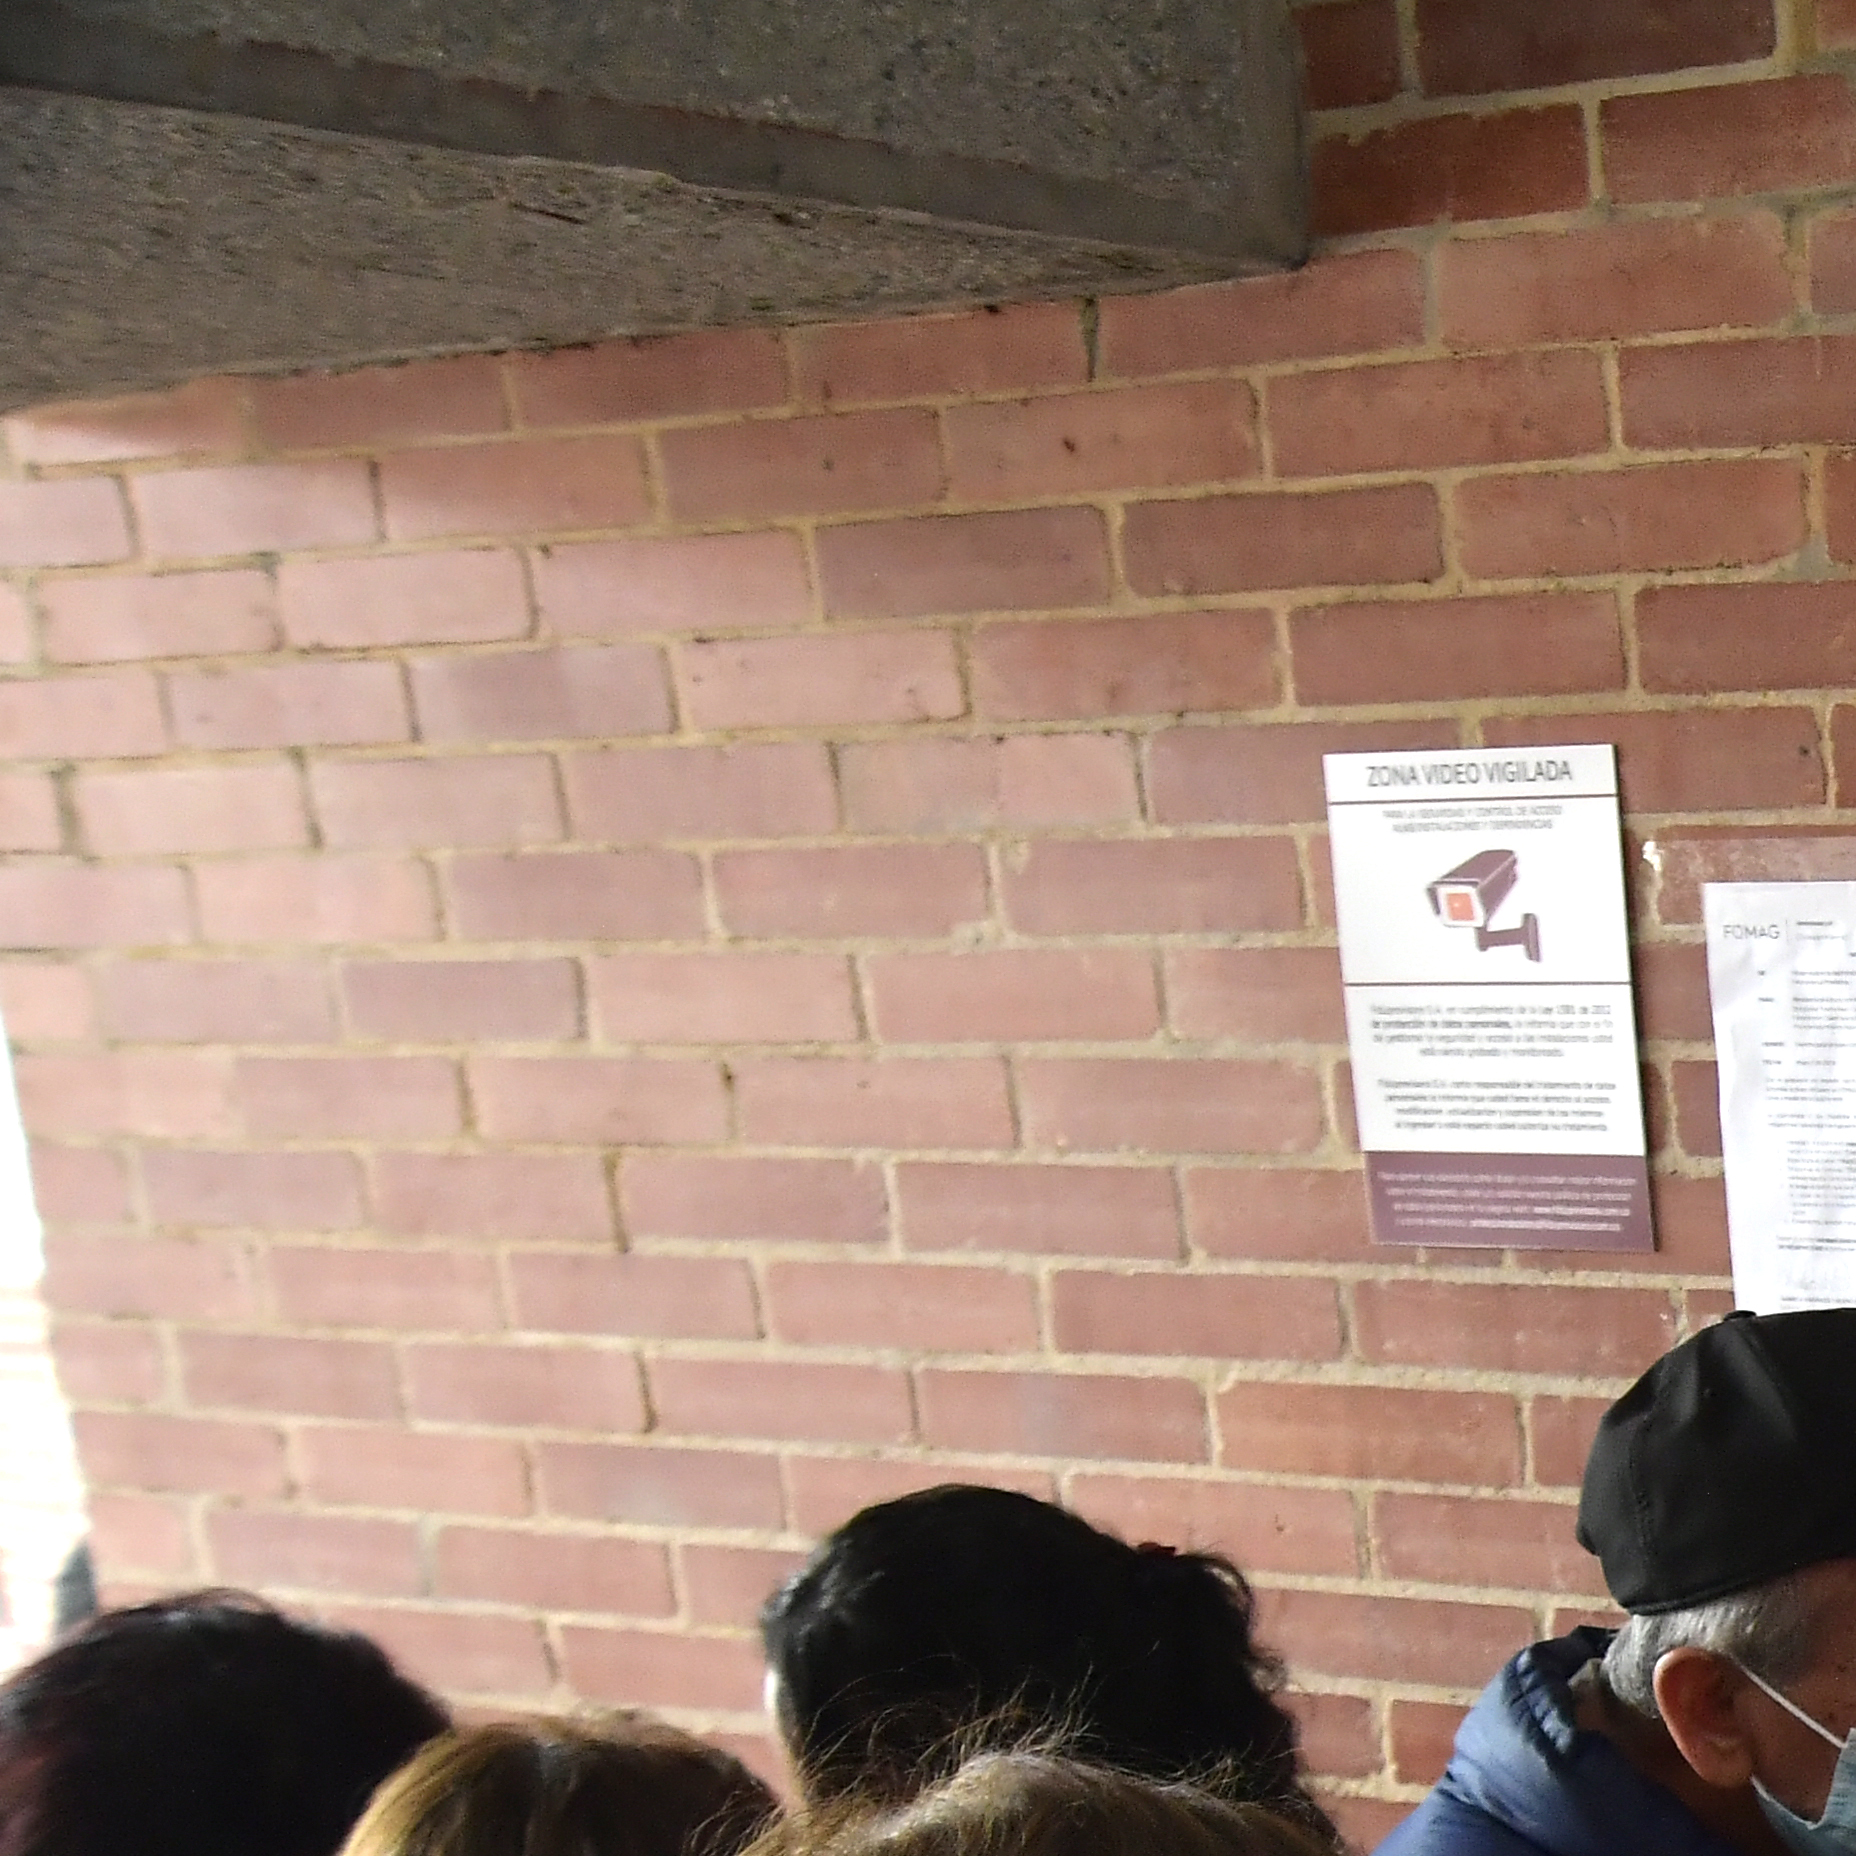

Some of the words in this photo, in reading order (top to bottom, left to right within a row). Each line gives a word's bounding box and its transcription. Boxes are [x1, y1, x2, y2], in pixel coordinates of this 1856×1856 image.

[1366, 765, 1418, 787] ZONA
[1422, 762, 1480, 785] VIDEO
[1483, 759, 1573, 784] VIGILADA
[1723, 923, 1781, 941] FOMAG
